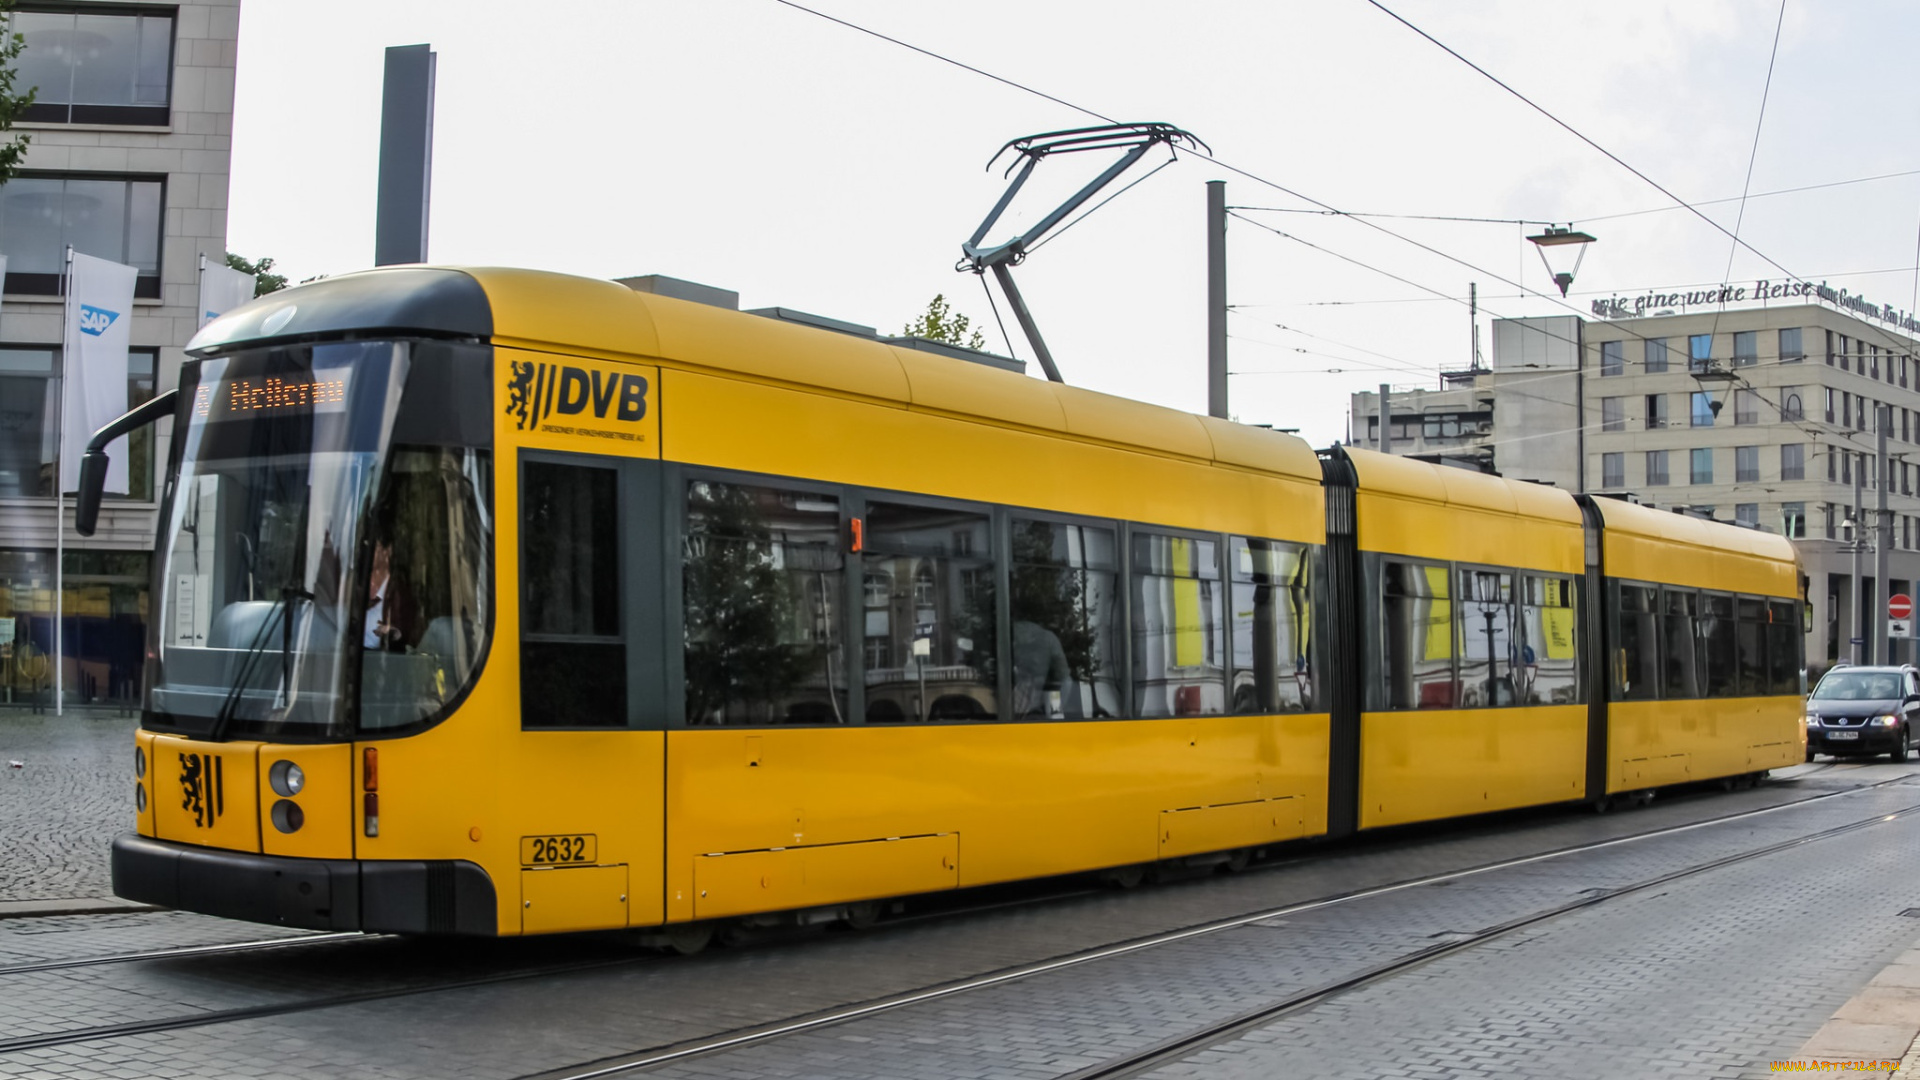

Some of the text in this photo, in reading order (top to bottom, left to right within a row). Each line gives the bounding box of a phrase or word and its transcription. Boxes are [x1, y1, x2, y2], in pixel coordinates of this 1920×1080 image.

[1591, 278, 1812, 315] wie eine weite Reise
[80, 309, 110, 332] SAP
[231, 378, 344, 411] Hellerau
[557, 365, 649, 422] DVB
[533, 837, 585, 863] 2632
